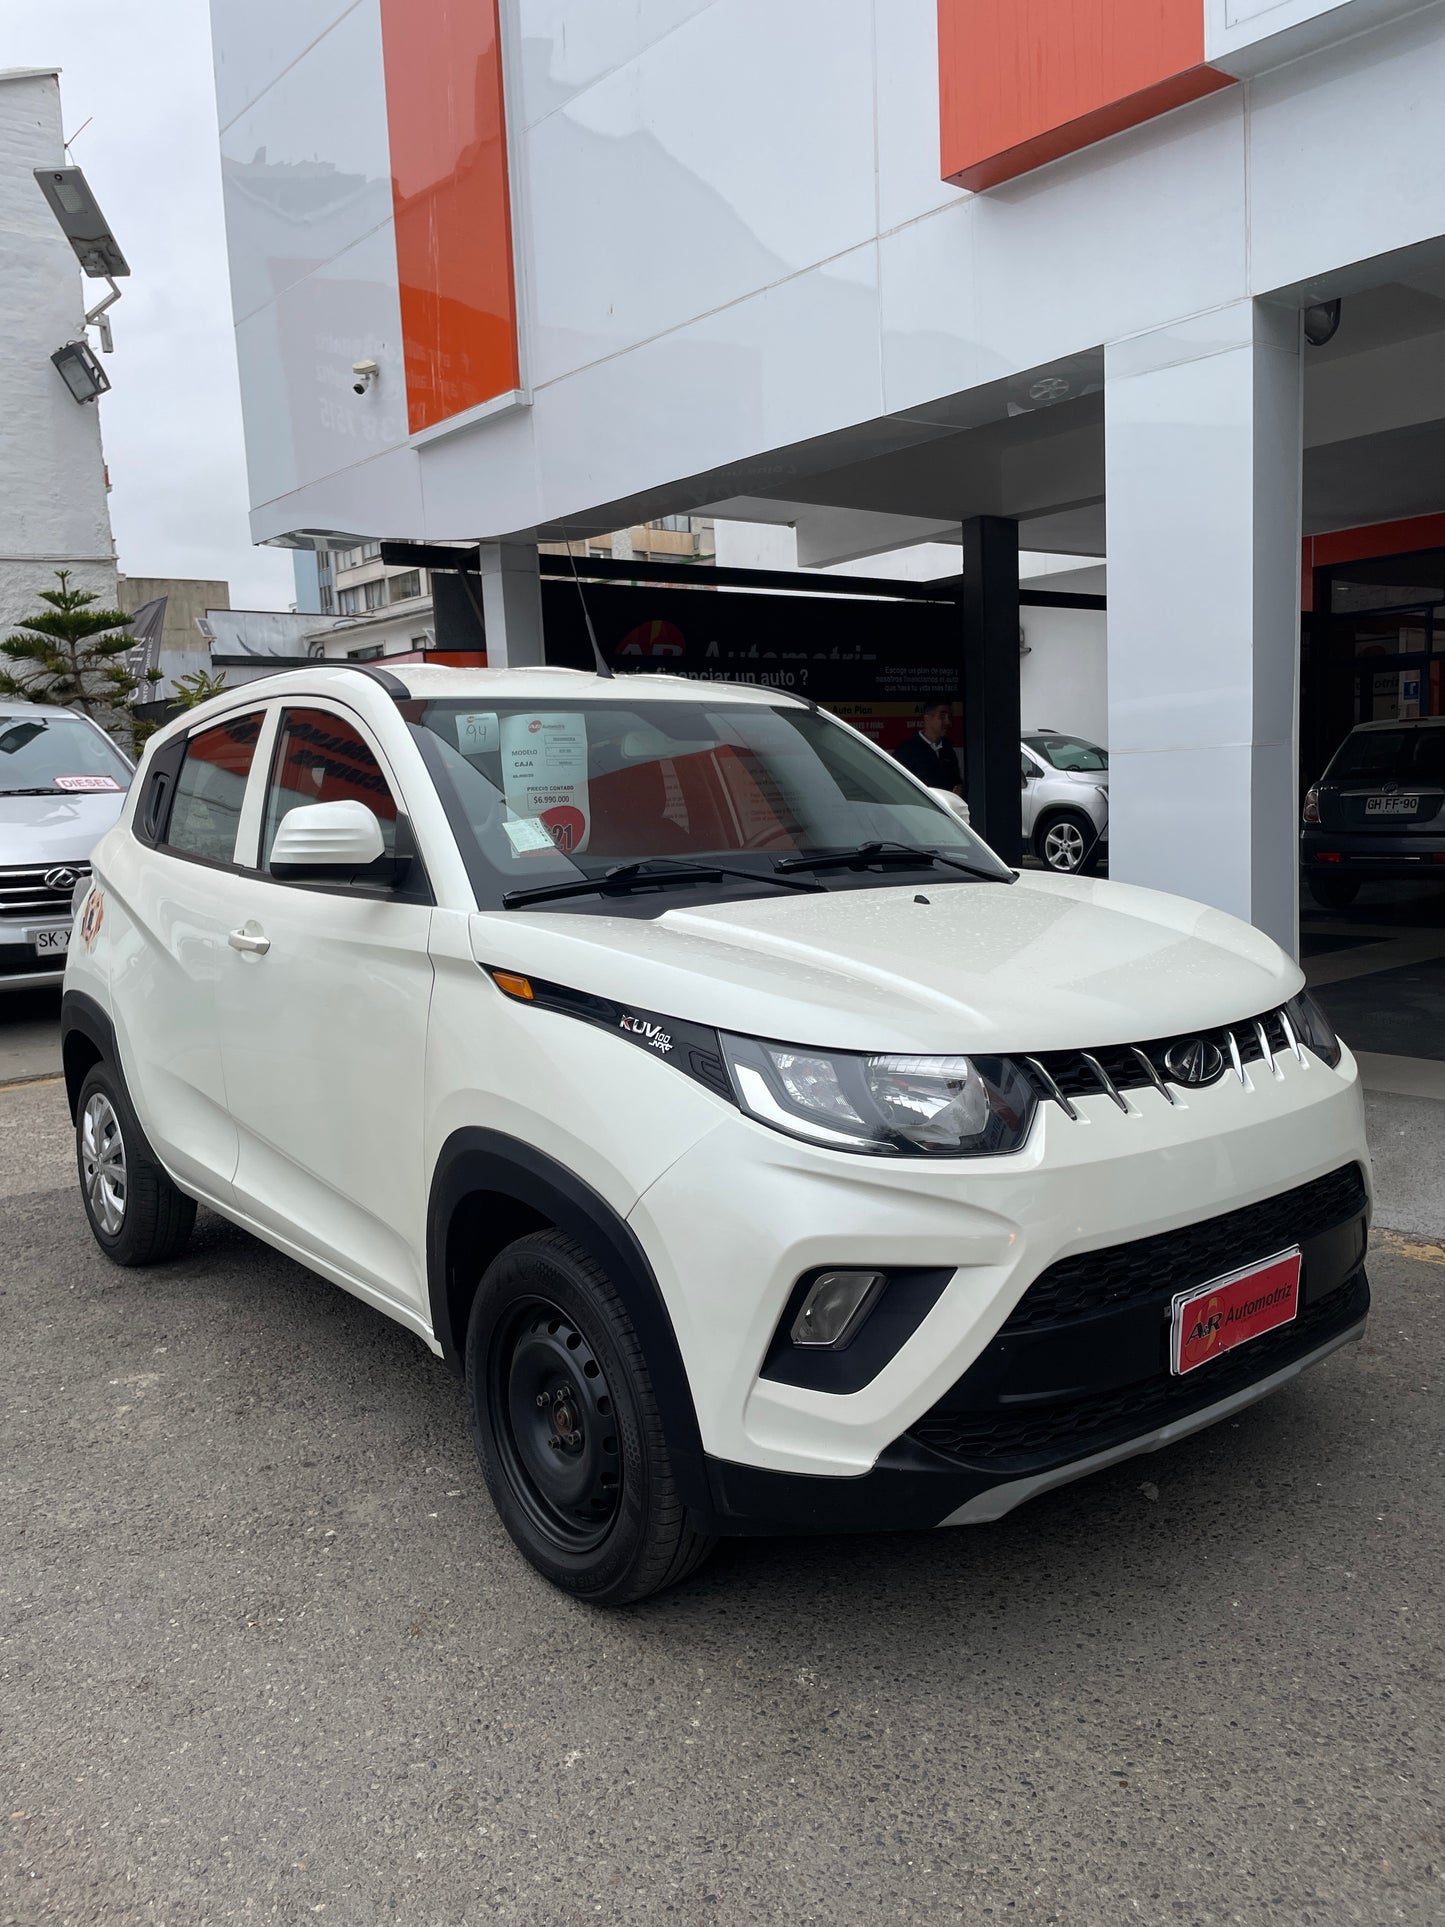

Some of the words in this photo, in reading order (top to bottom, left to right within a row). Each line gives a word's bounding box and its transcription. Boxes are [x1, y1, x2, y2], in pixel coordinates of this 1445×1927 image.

[760, 670, 795, 686] auto
[799, 668, 809, 686] ?
[832, 705, 852, 714] Auto
[855, 705, 873, 714] Plan
[466, 724, 487, 744] 94
[61, 779, 114, 788] DIESEL
[533, 796, 570, 804] $6.990.000
[1368, 799, 1382, 810] GH
[1225, 1283, 1293, 1325] Automotriz
